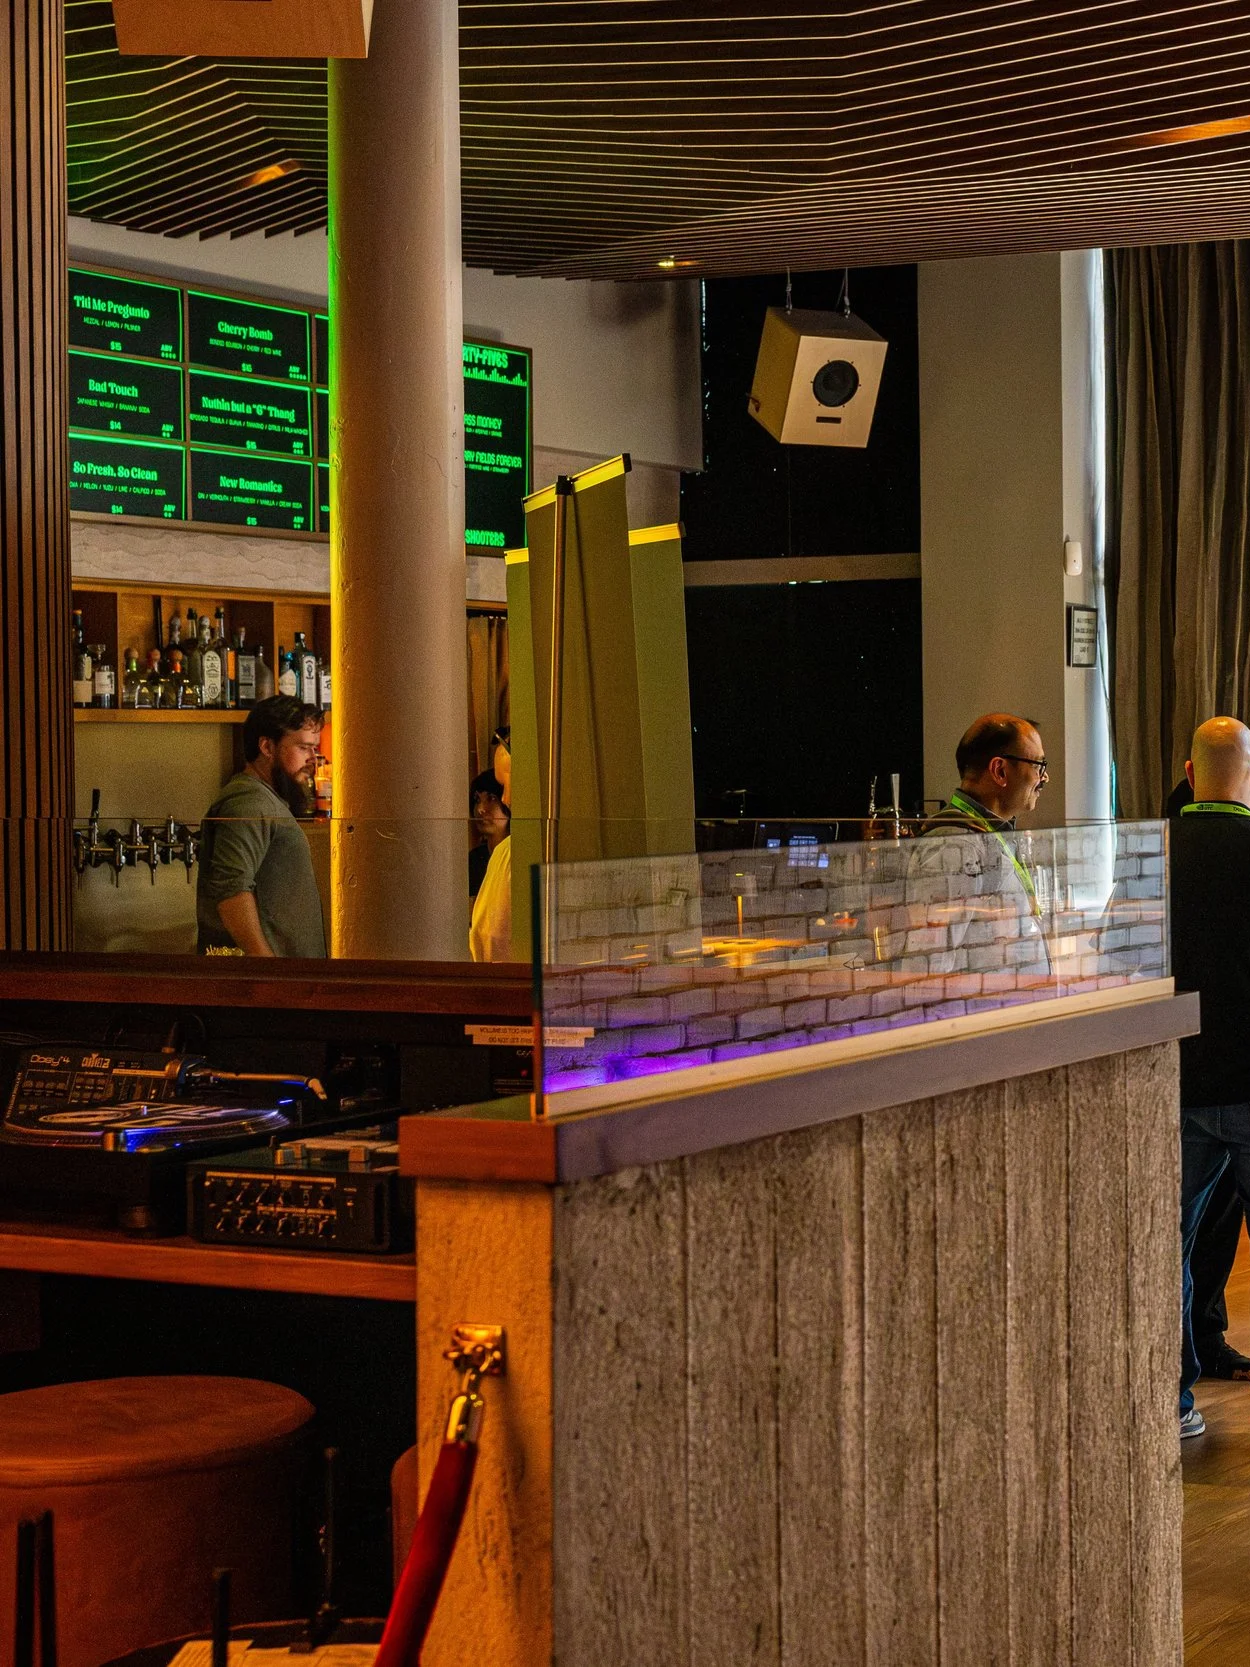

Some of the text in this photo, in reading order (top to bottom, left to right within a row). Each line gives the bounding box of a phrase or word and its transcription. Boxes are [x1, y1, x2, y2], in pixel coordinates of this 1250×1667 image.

[92, 298, 106, 312] Me
[218, 321, 273, 341] Cherry Bomb
[161, 344, 172, 352] ABV
[463, 345, 508, 369] RTY-FIVES
[89, 379, 138, 397] Bad Touch
[139, 406, 150, 414] SODA
[202, 397, 295, 423] Nuthin but a "G" Thang
[110, 420, 121, 430] $14
[210, 416, 225, 424] TEQUILA
[464, 414, 502, 430] ASS MONKEY
[162, 424, 174, 432] ABV
[292, 441, 303, 449] ABV
[476, 452, 496, 466] FIELDS
[496, 454, 522, 468] FOREVER
[74, 461, 85, 474] So
[117, 466, 129, 478] So
[131, 467, 158, 481] Clean
[83, 482, 98, 490] MELON
[133, 487, 150, 495] CALPICO
[155, 488, 166, 496] SODA
[220, 475, 283, 493] New Romantics
[112, 505, 123, 513] $14
[164, 504, 175, 512] ABV
[465, 529, 505, 546] SHOOTERS
